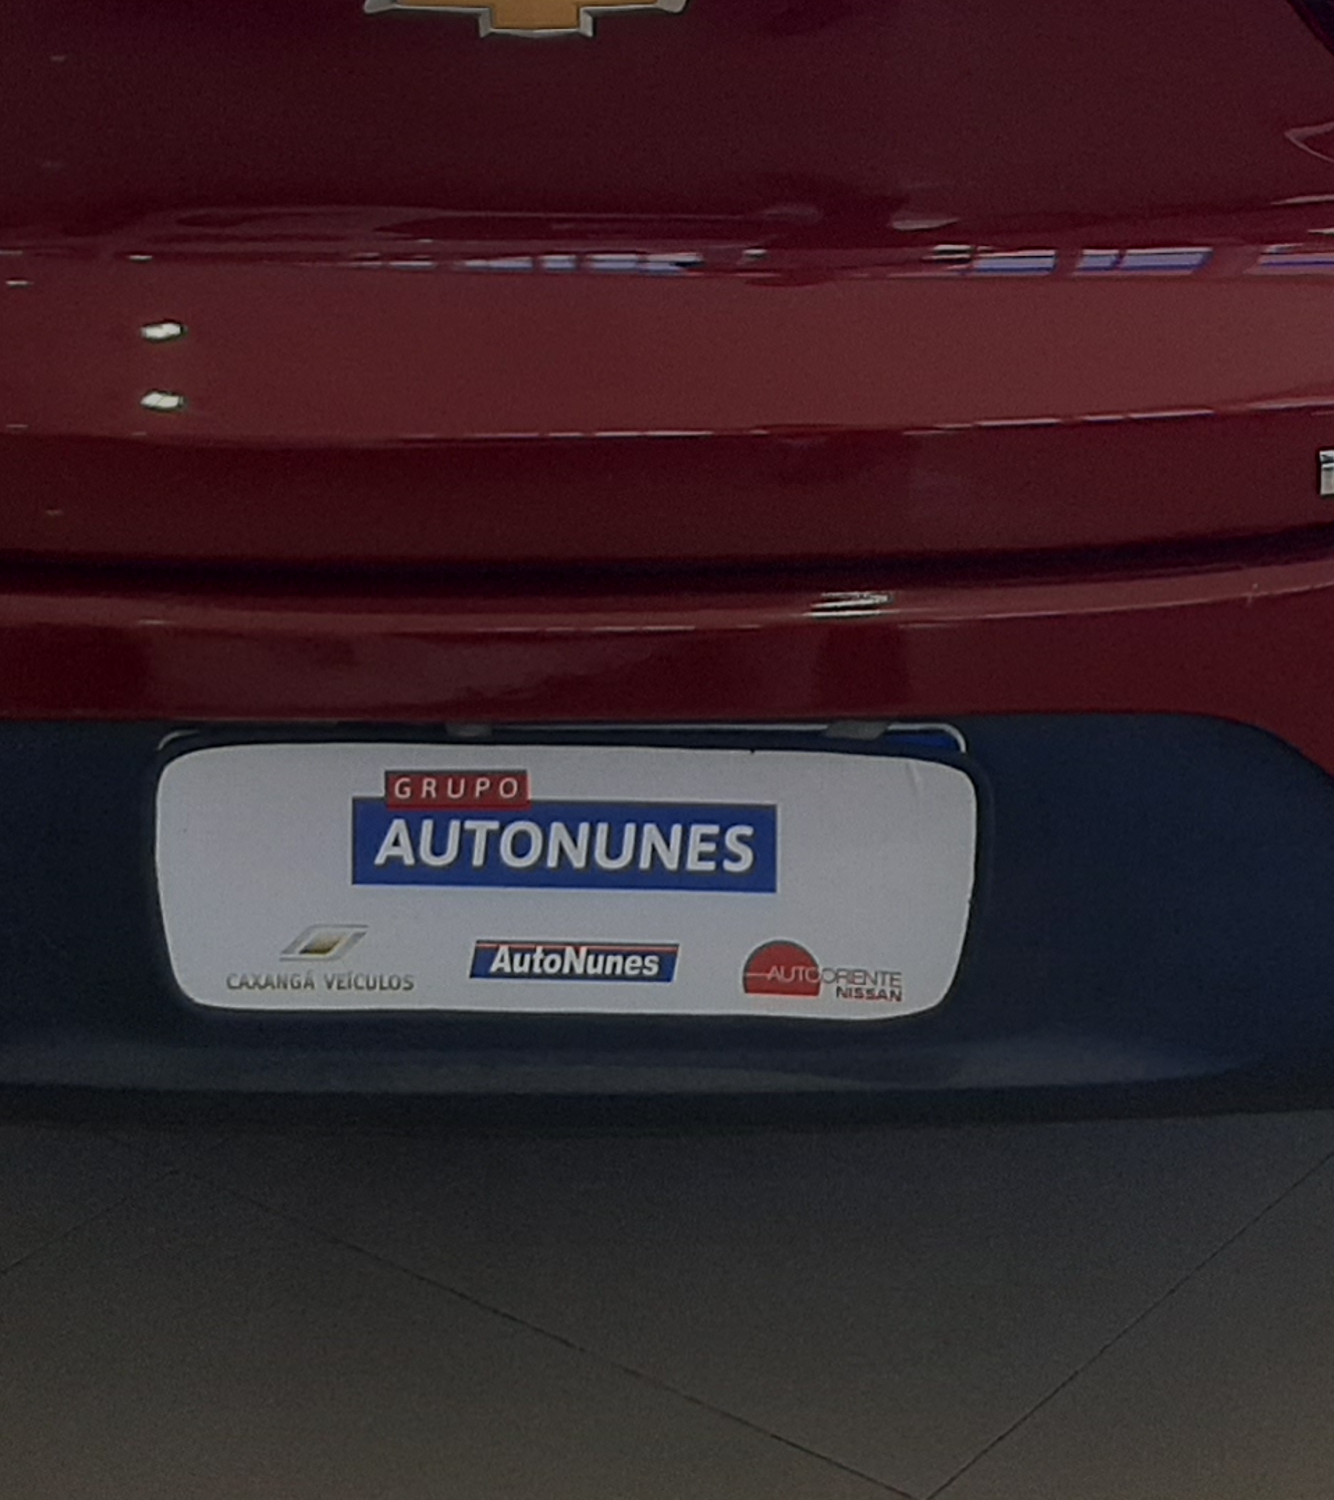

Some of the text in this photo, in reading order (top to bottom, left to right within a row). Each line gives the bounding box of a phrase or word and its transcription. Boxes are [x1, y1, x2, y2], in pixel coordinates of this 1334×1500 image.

[394, 776, 519, 800] GRUPO
[374, 818, 755, 874] AUTONUNES
[490, 945, 661, 977] AutoNunes
[226, 969, 415, 992] CAXANGÁ VEÍCULOS
[835, 985, 903, 1003] NISSAN
